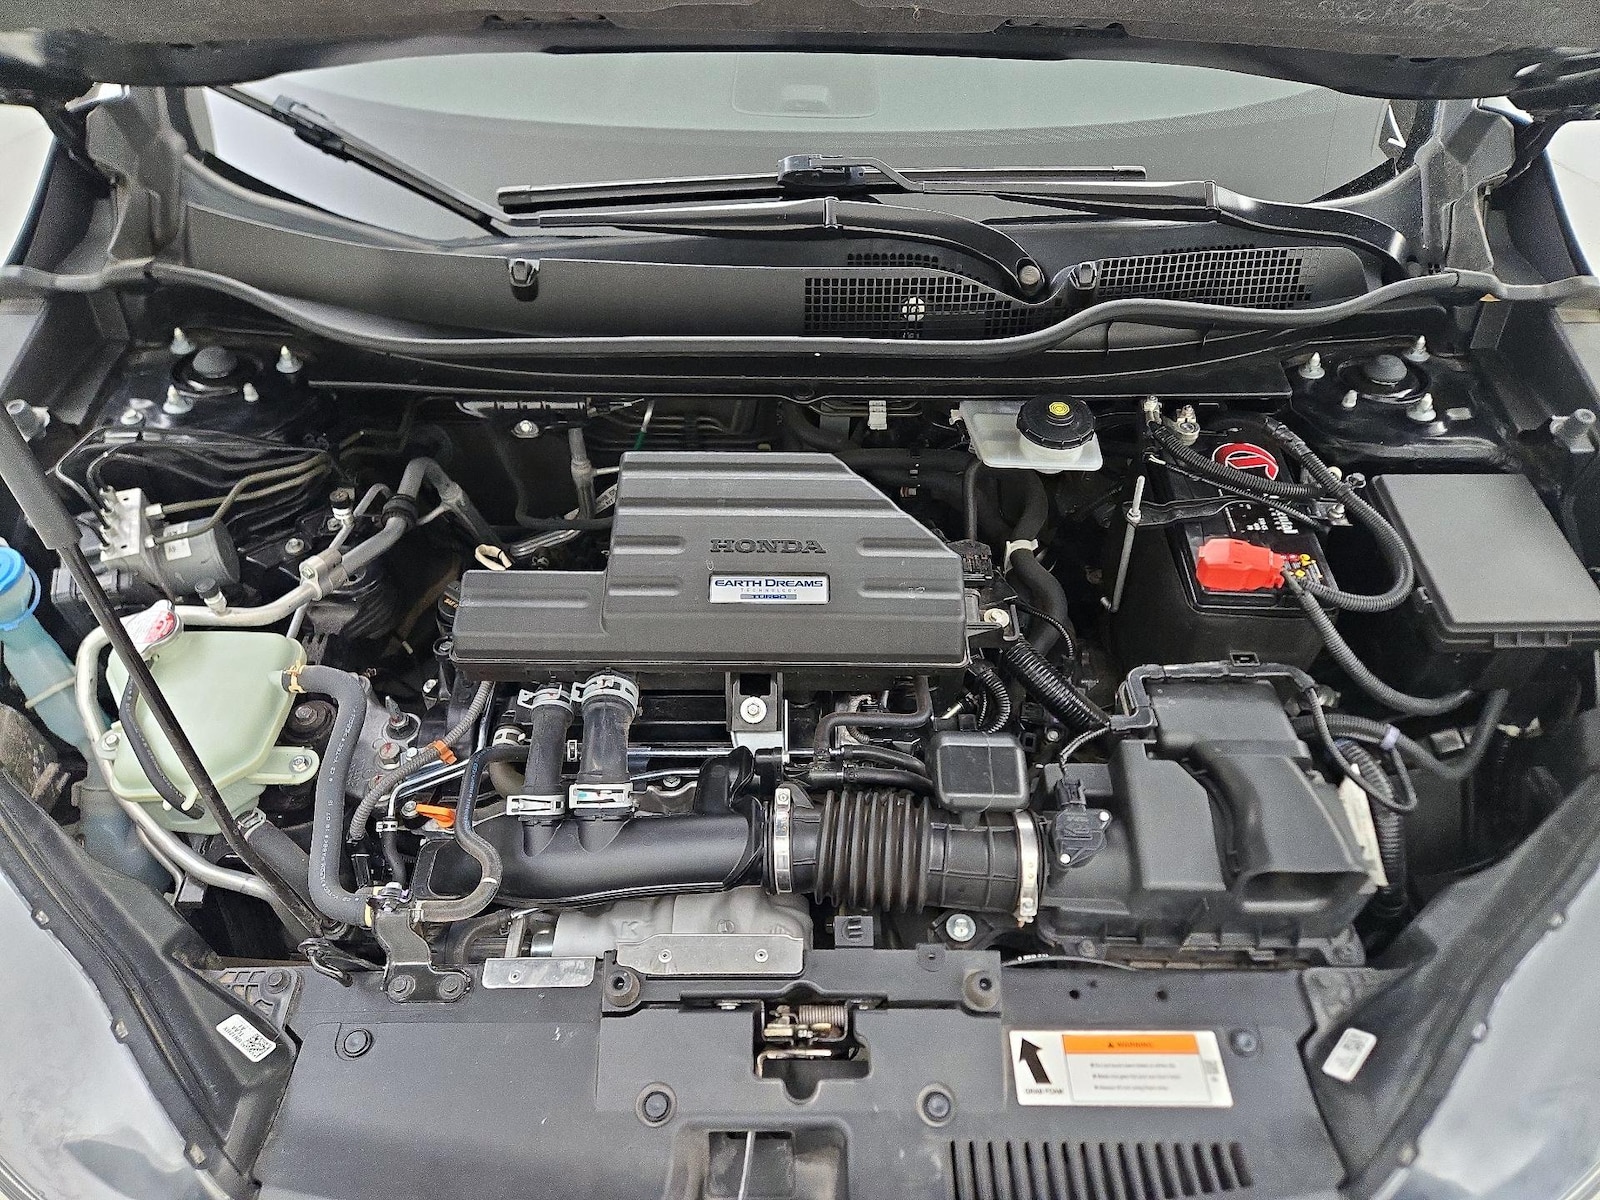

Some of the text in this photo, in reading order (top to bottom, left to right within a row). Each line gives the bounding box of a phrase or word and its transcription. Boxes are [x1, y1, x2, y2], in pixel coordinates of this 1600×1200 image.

[710, 539, 827, 554] HONDA
[714, 578, 823, 588] EARTH DREAMS
